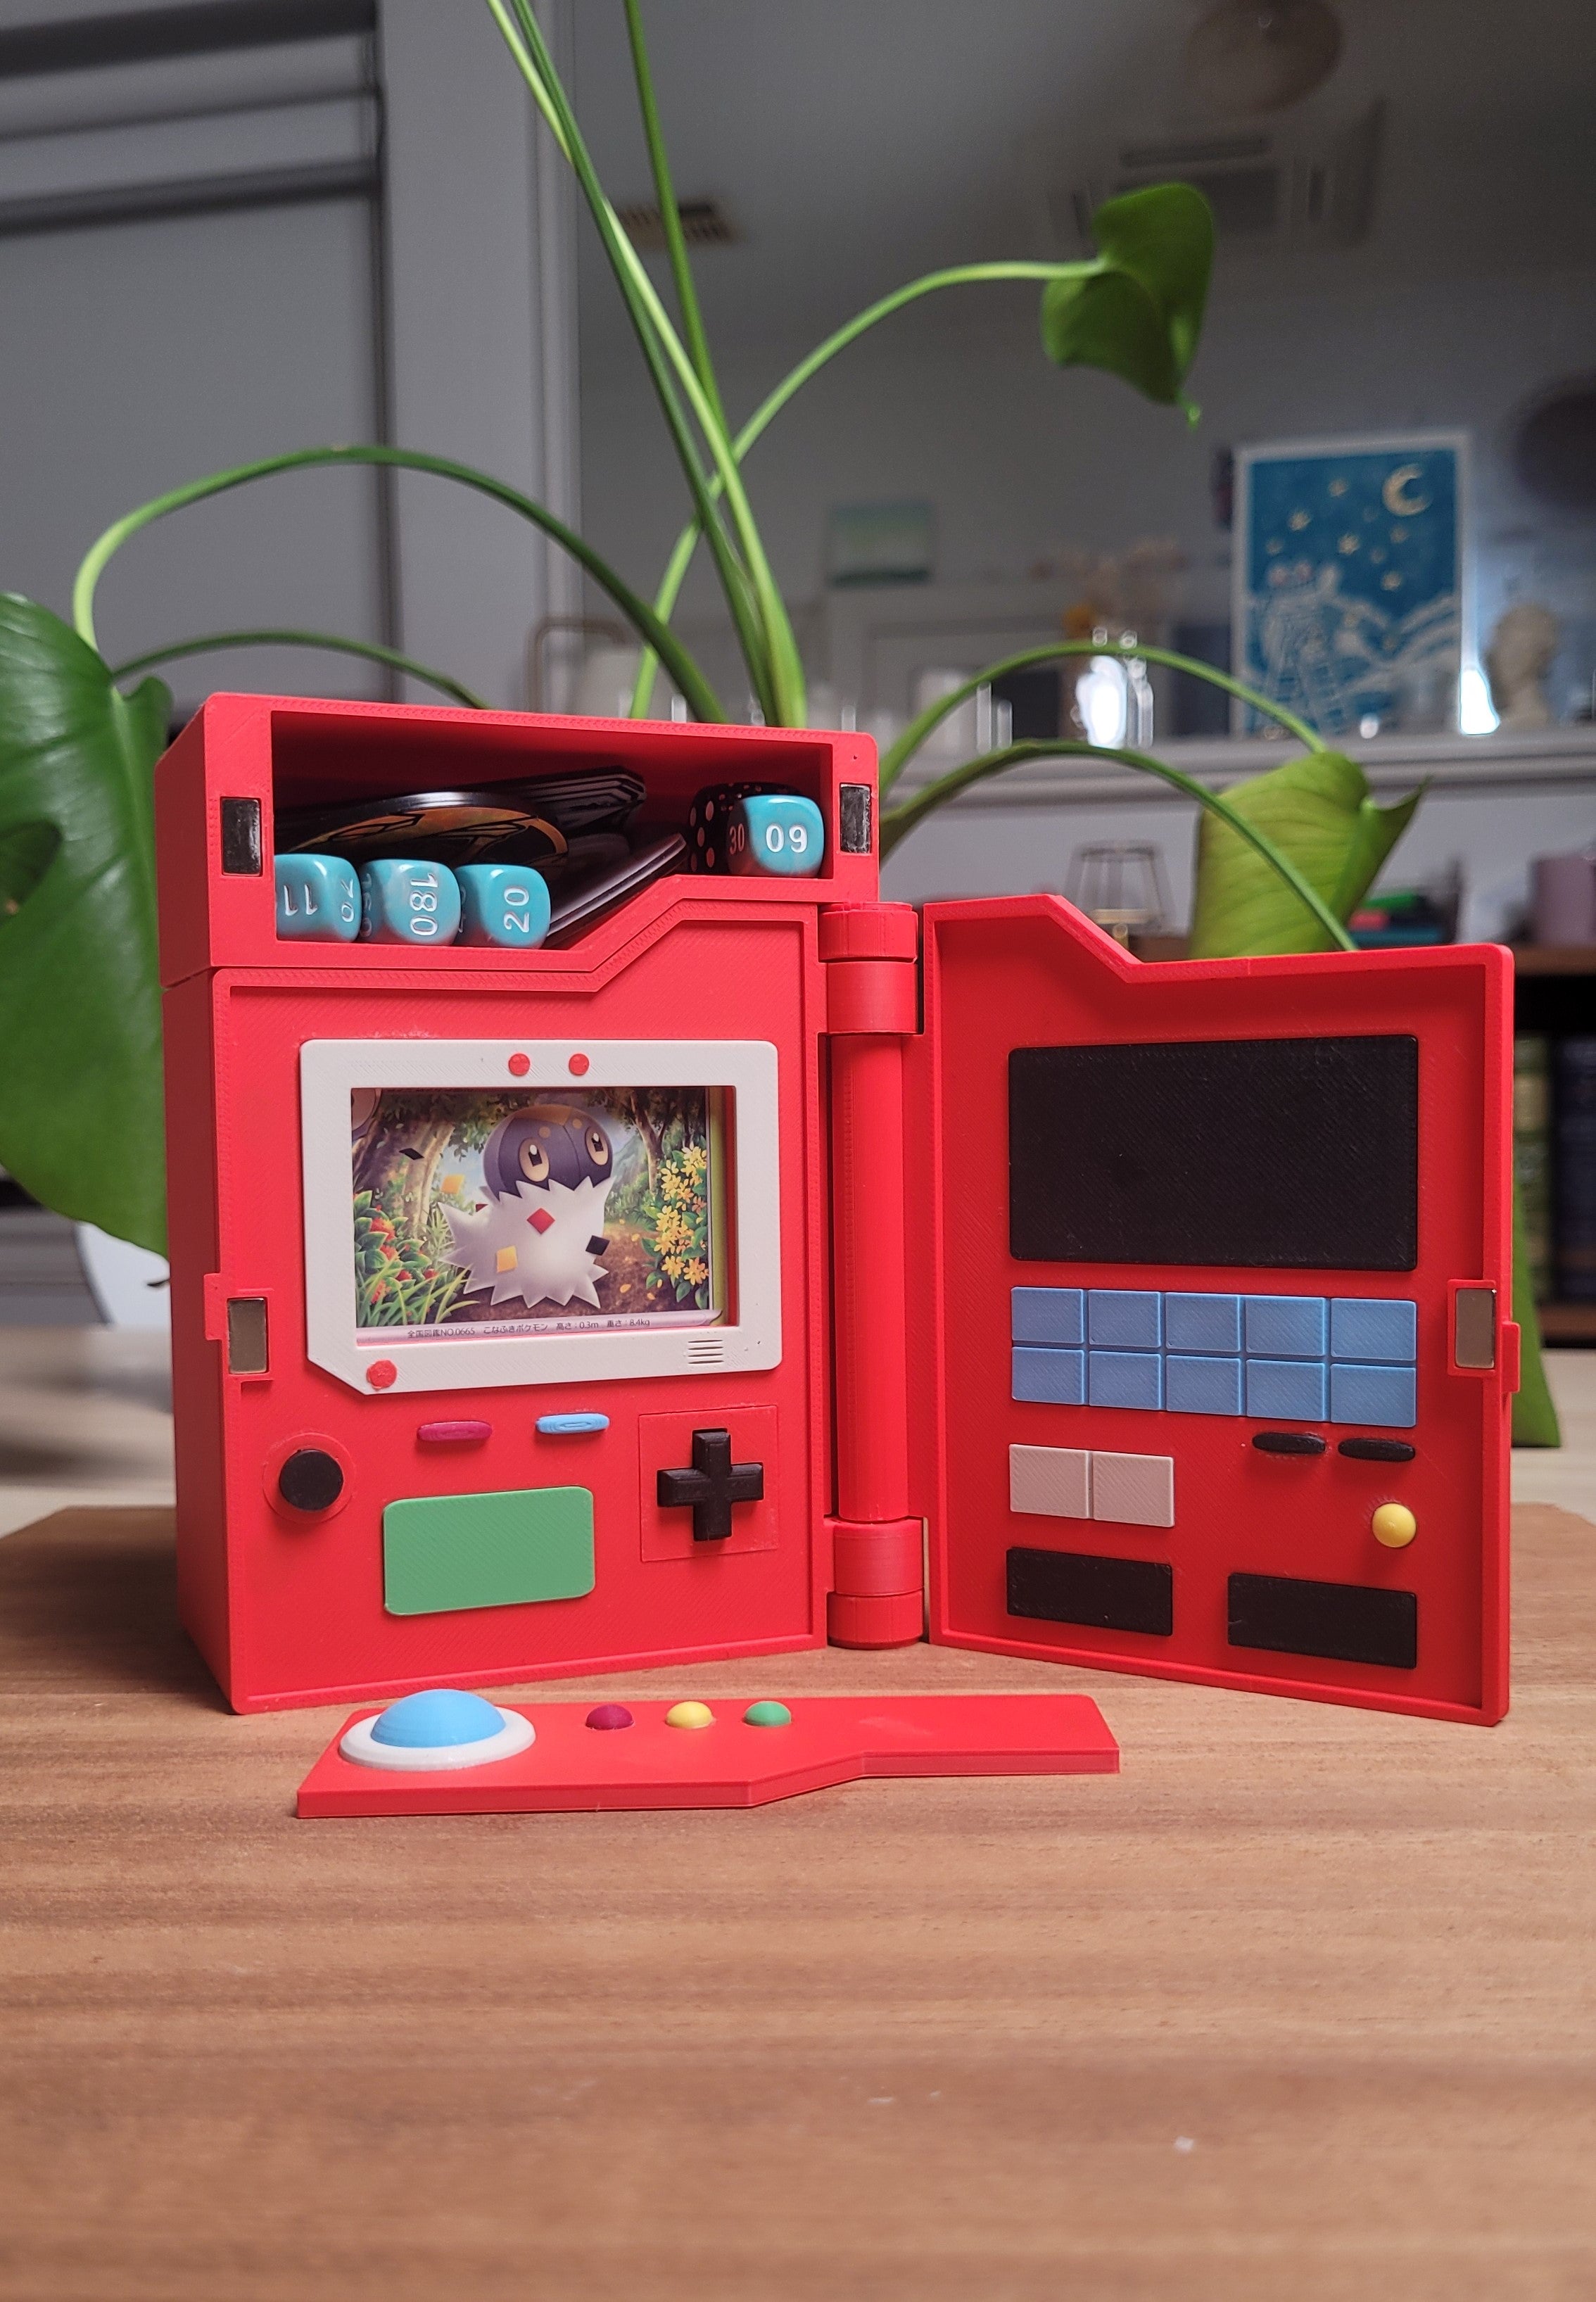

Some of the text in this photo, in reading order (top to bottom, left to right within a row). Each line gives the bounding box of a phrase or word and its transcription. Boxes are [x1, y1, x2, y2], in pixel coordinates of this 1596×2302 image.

[729, 823, 745, 855] 30
[410, 873, 438, 936] 180
[504, 885, 530, 933] 20
